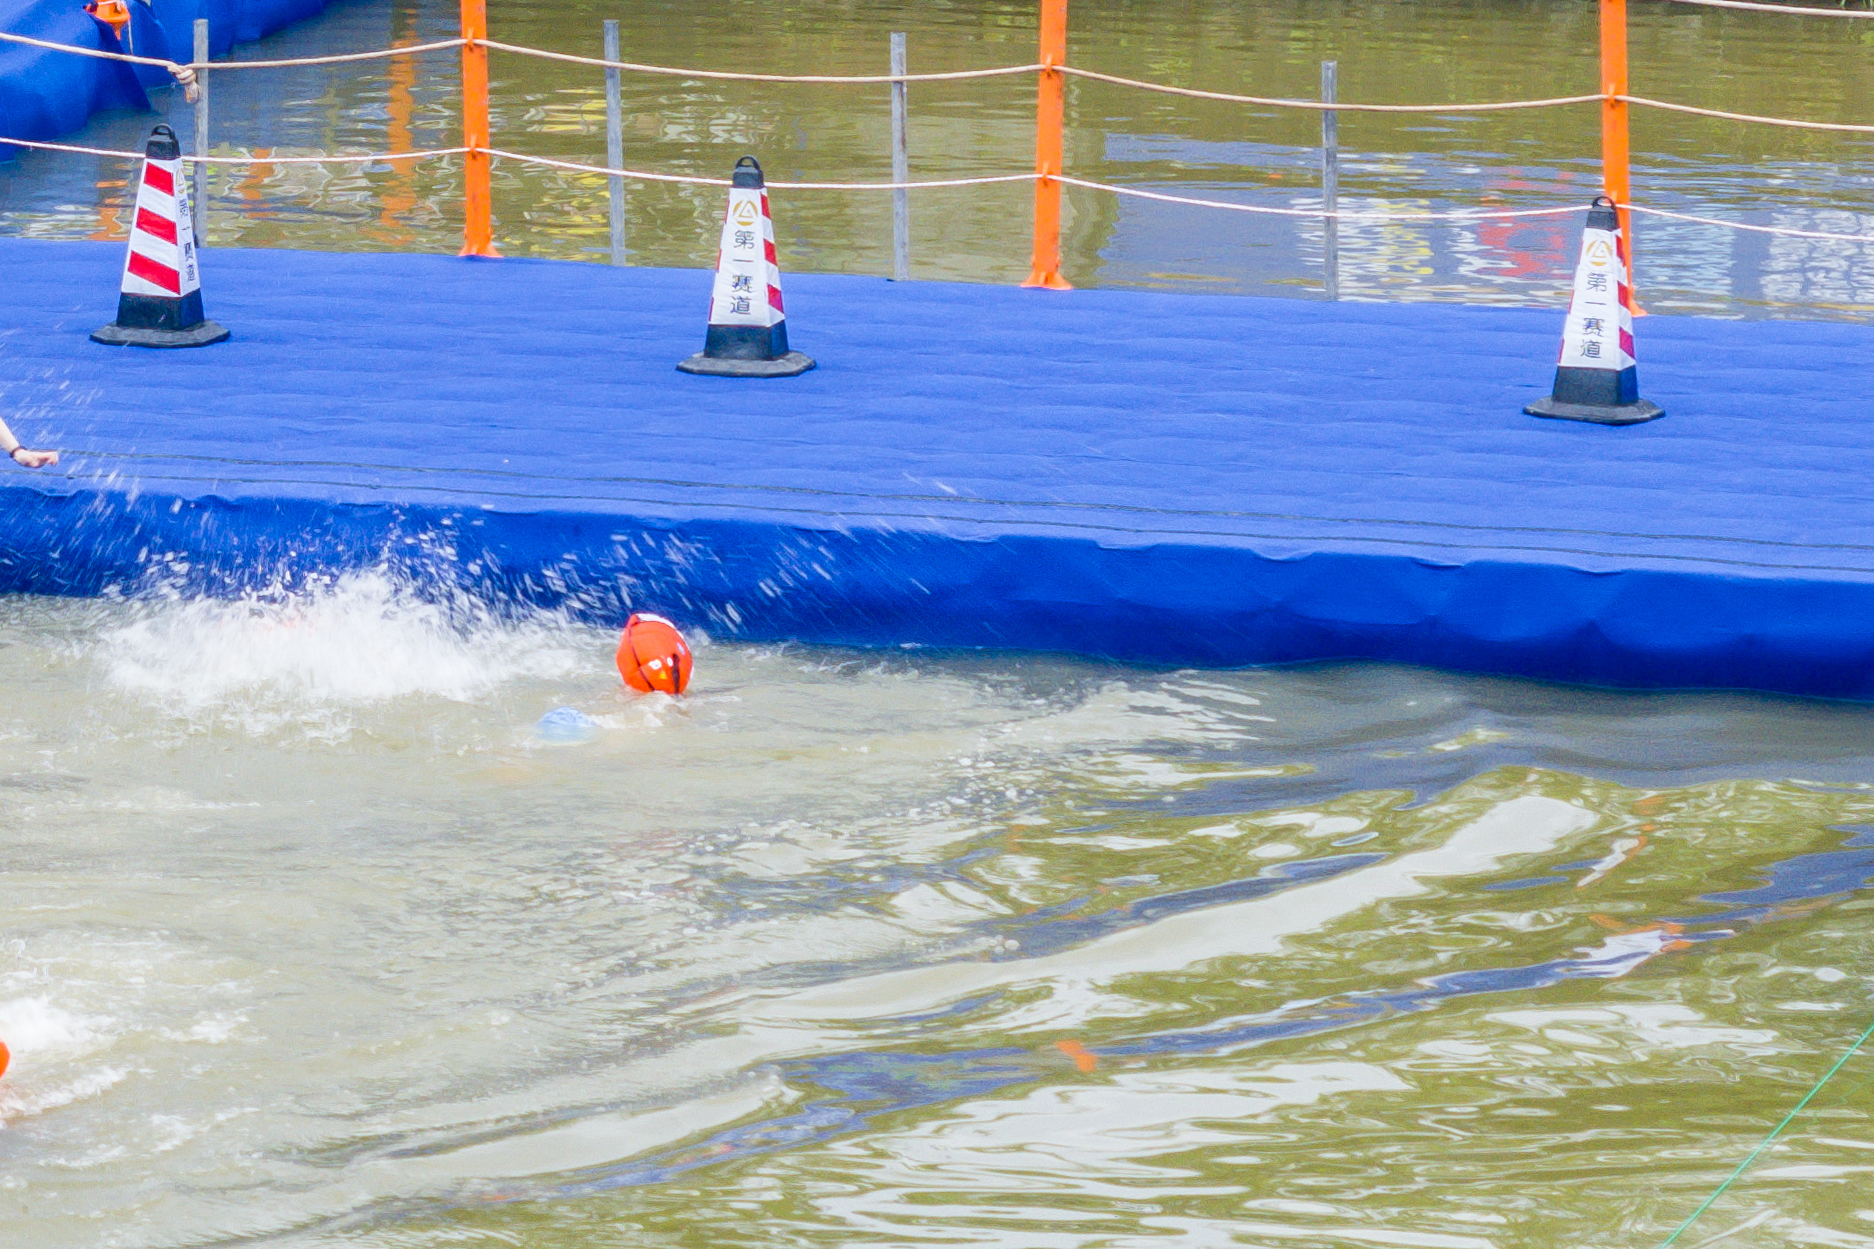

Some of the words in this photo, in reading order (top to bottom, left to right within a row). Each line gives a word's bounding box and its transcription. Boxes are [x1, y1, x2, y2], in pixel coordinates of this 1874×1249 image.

[730, 228, 756, 316] 第一赛道
[1579, 270, 1607, 359] 第一赛道
